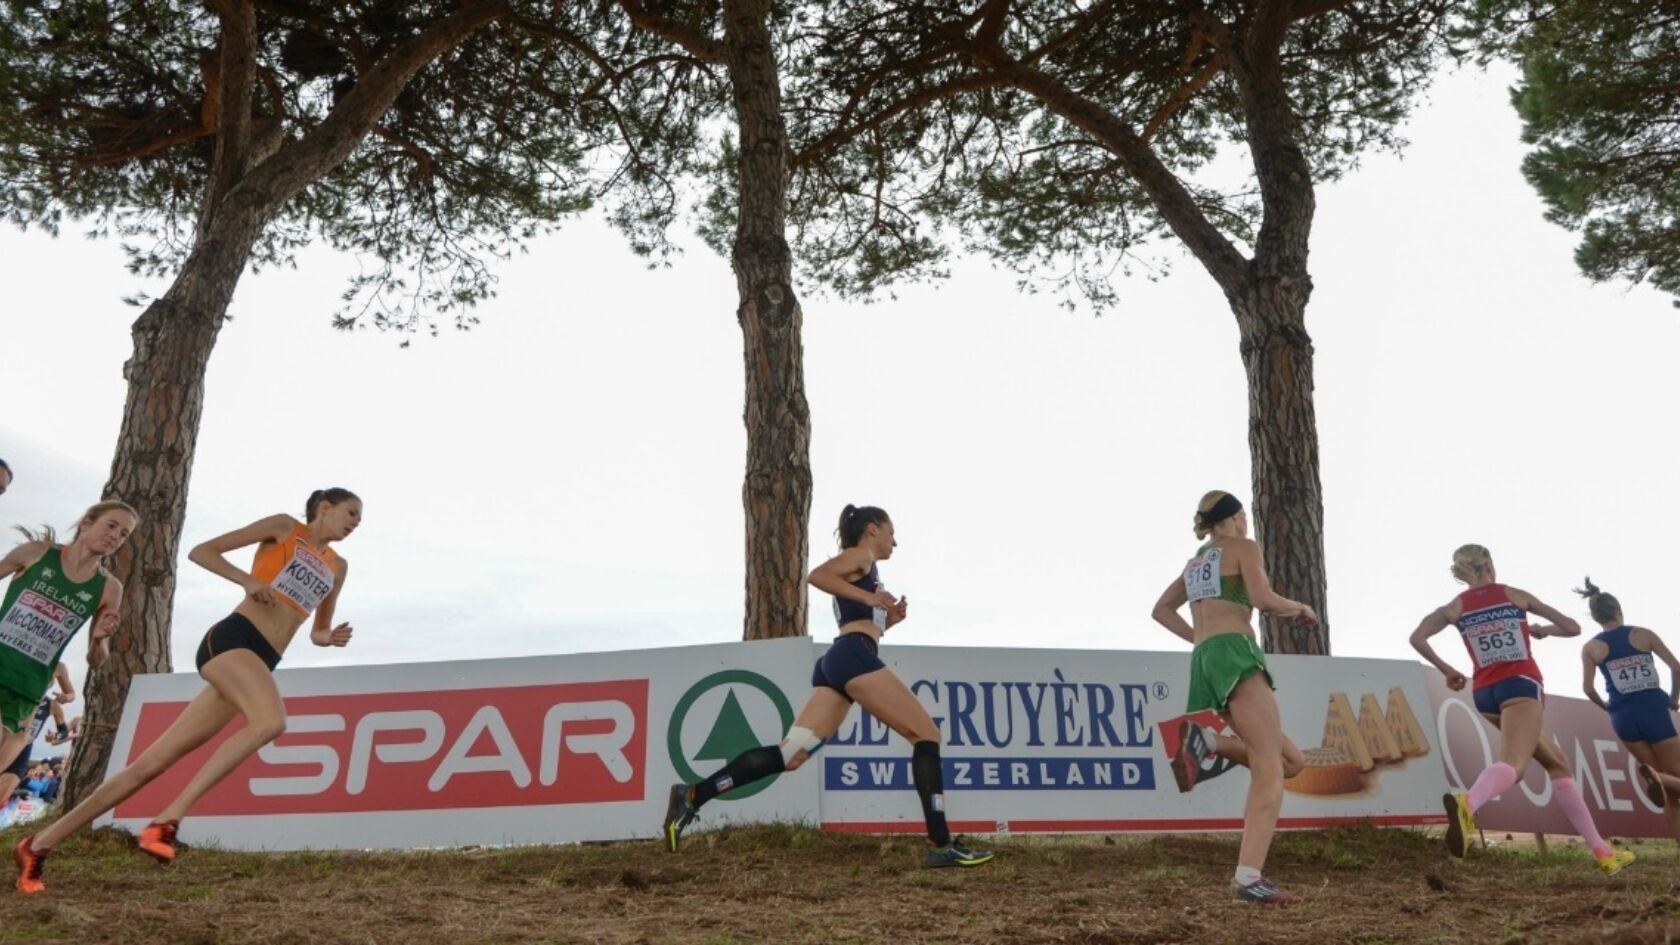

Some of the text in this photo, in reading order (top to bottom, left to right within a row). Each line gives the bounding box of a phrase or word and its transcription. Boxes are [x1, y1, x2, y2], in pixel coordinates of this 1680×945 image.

[286, 559, 330, 600] KOSTER
[20, 592, 67, 623] SPAR
[32, 580, 87, 614] IRELAND
[7, 606, 67, 646] McCORMACK
[1478, 631, 1517, 652] 563
[1619, 664, 1651, 681] 475
[910, 667, 1154, 749] RUYÈRE
[248, 700, 634, 796] SPAR
[840, 761, 1142, 786] SWIZERLAND
